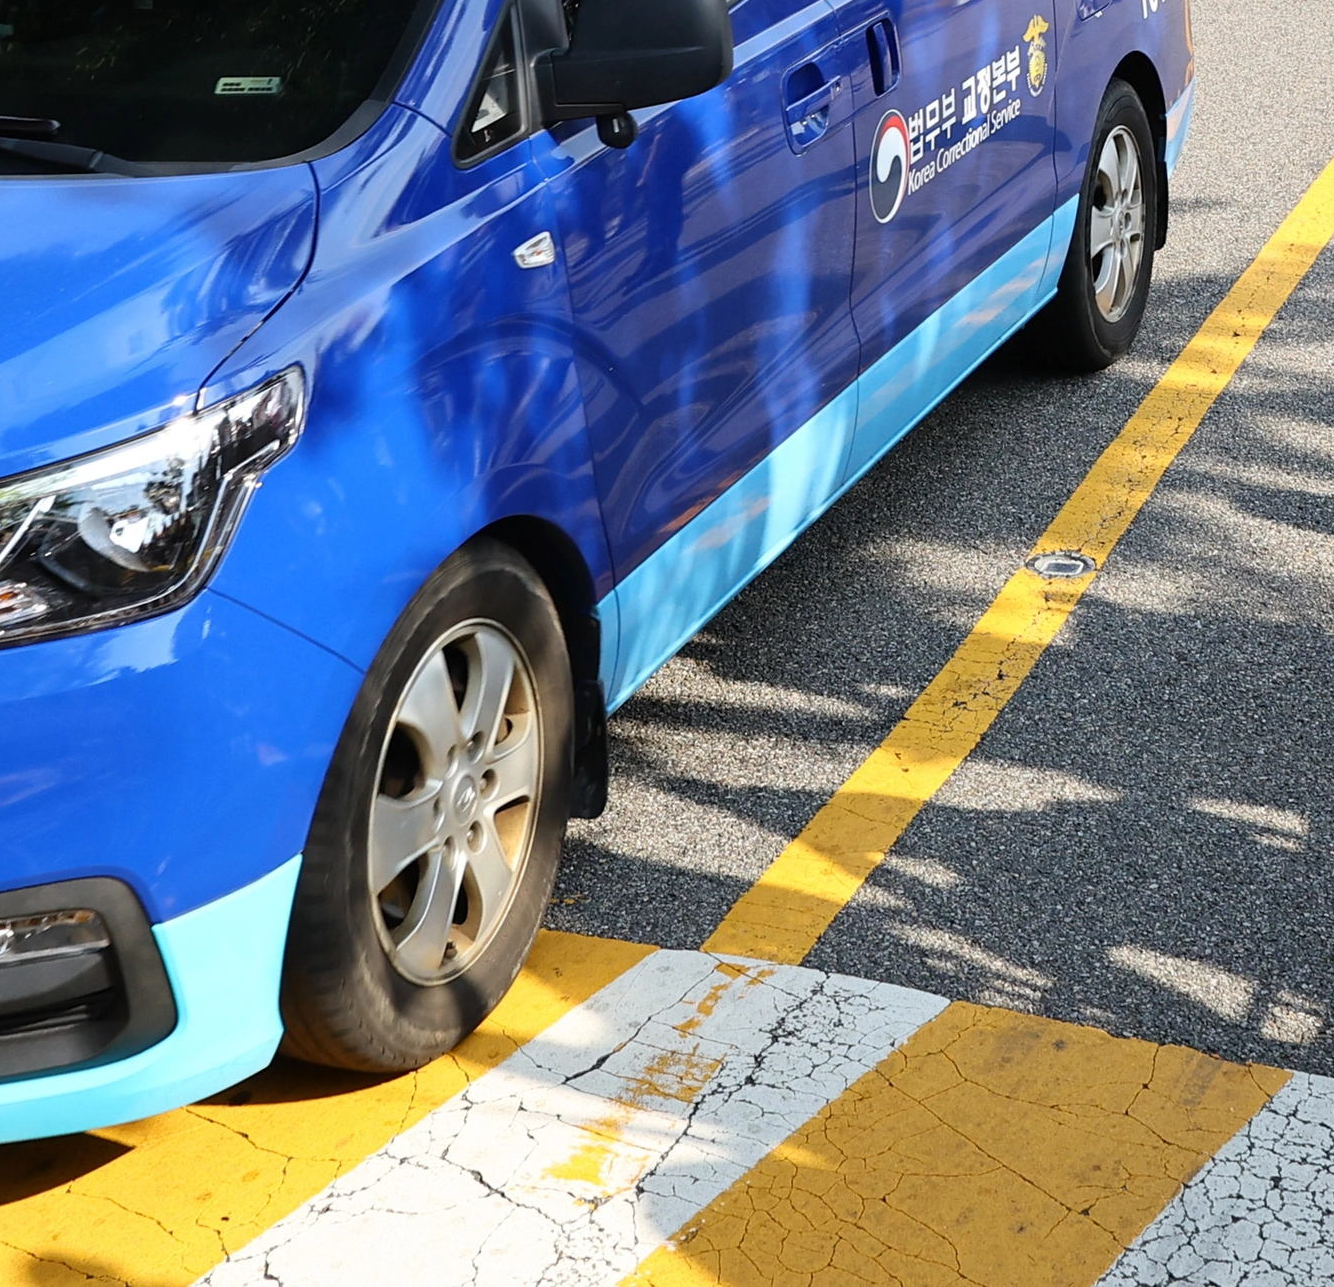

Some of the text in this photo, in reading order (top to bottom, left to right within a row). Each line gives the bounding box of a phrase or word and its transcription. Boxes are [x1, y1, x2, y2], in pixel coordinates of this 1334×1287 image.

[907, 87, 957, 165] 법무부
[961, 45, 1021, 126] 교정본부
[907, 98, 1021, 196] Korea Correctional Service
